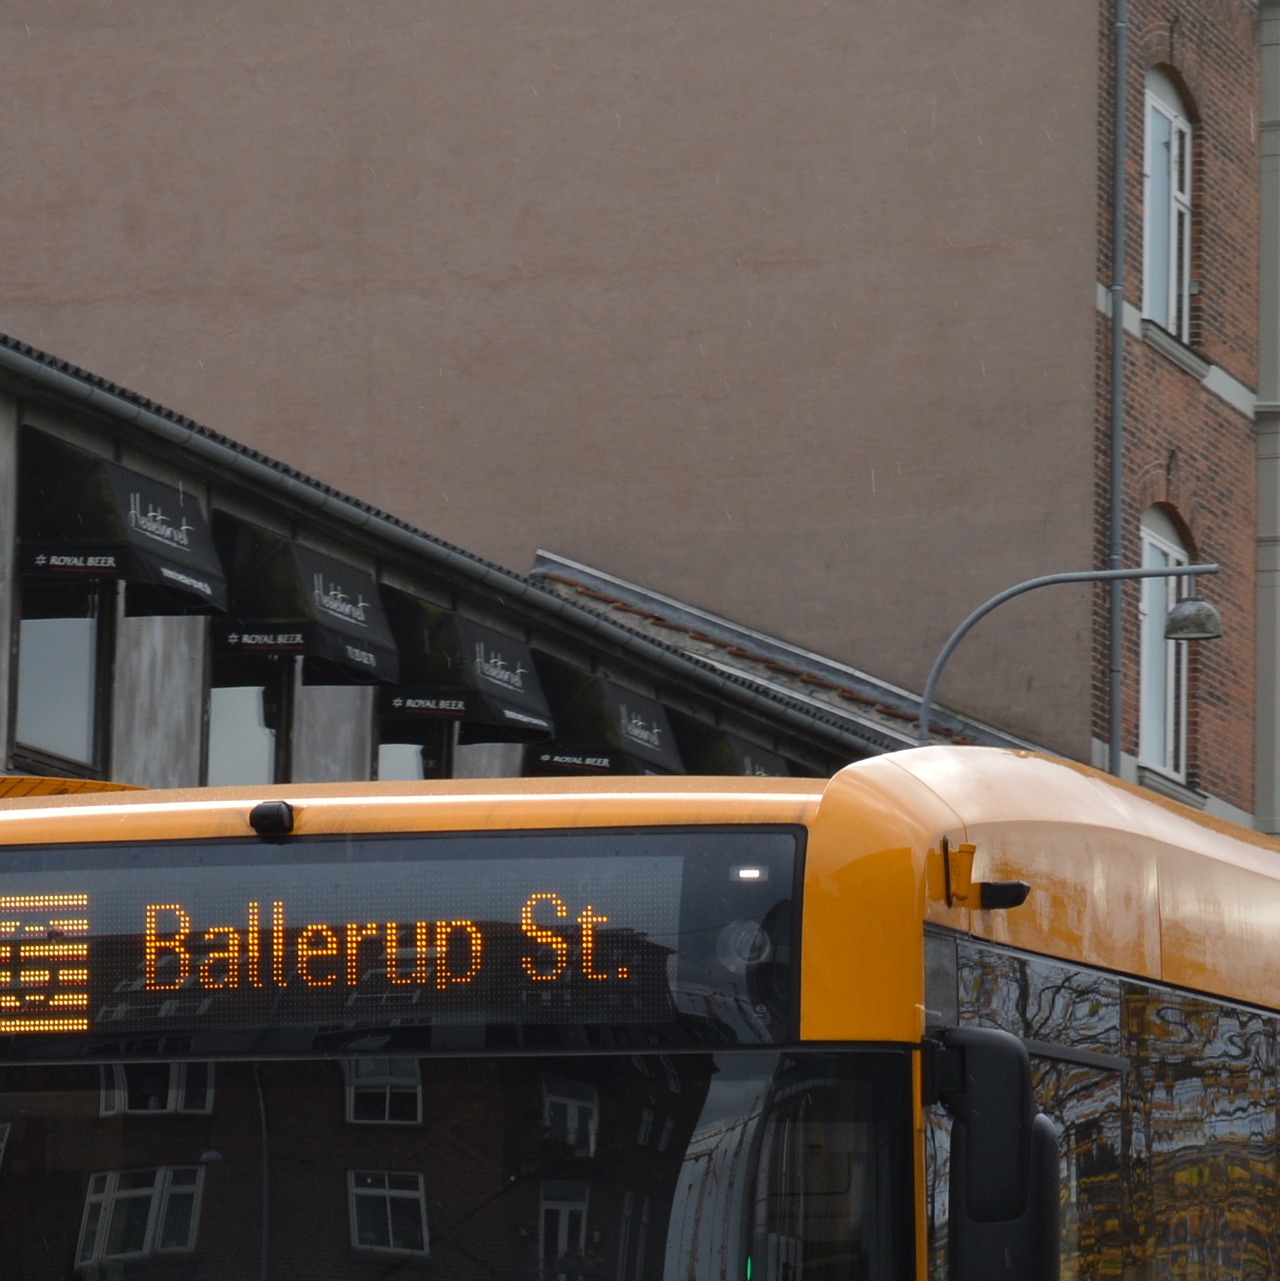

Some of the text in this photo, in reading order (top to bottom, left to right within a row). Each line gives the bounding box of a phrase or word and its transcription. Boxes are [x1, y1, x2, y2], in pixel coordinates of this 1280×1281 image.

[49, 555, 116, 567] ROYAL BEER
[241, 633, 304, 644] ROYAL BEER
[405, 698, 466, 710] ROYAL BEER
[145, 901, 483, 990] Ballerup
[521, 893, 629, 981] St.
